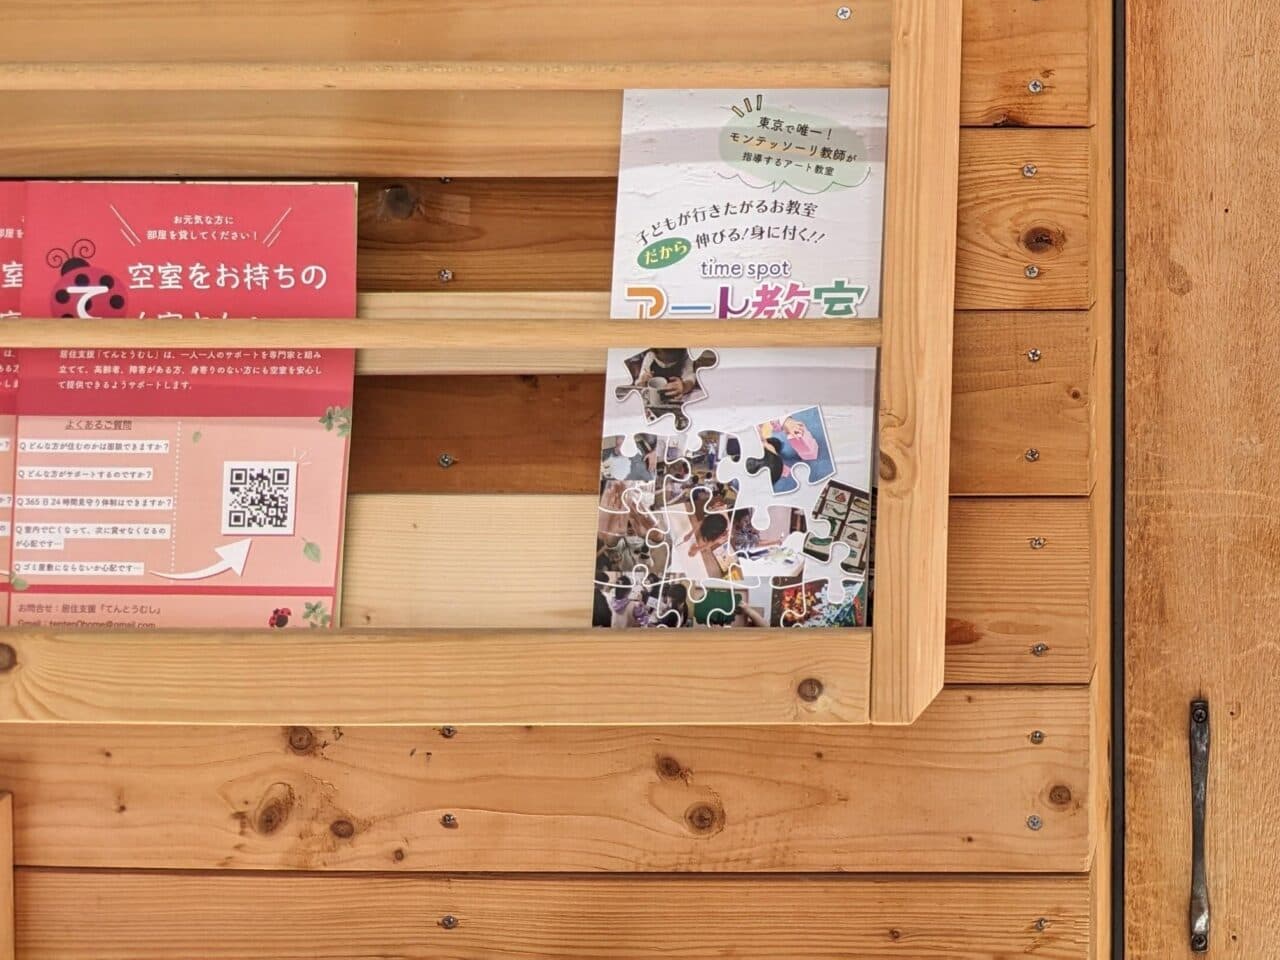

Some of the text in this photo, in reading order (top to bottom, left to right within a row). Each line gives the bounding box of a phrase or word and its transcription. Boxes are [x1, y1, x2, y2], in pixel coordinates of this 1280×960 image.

[757, 116, 834, 141] 東京で唯一！
[730, 131, 858, 164] モンテッソーリ教師が
[742, 151, 836, 177] 指導するアート教室
[173, 214, 234, 226] お元気な方に
[636, 199, 819, 246] 子どもが行きたがるお教室
[643, 240, 689, 266] だから
[128, 262, 328, 291] 空室をお持ちの
[701, 259, 792, 280] time spot
